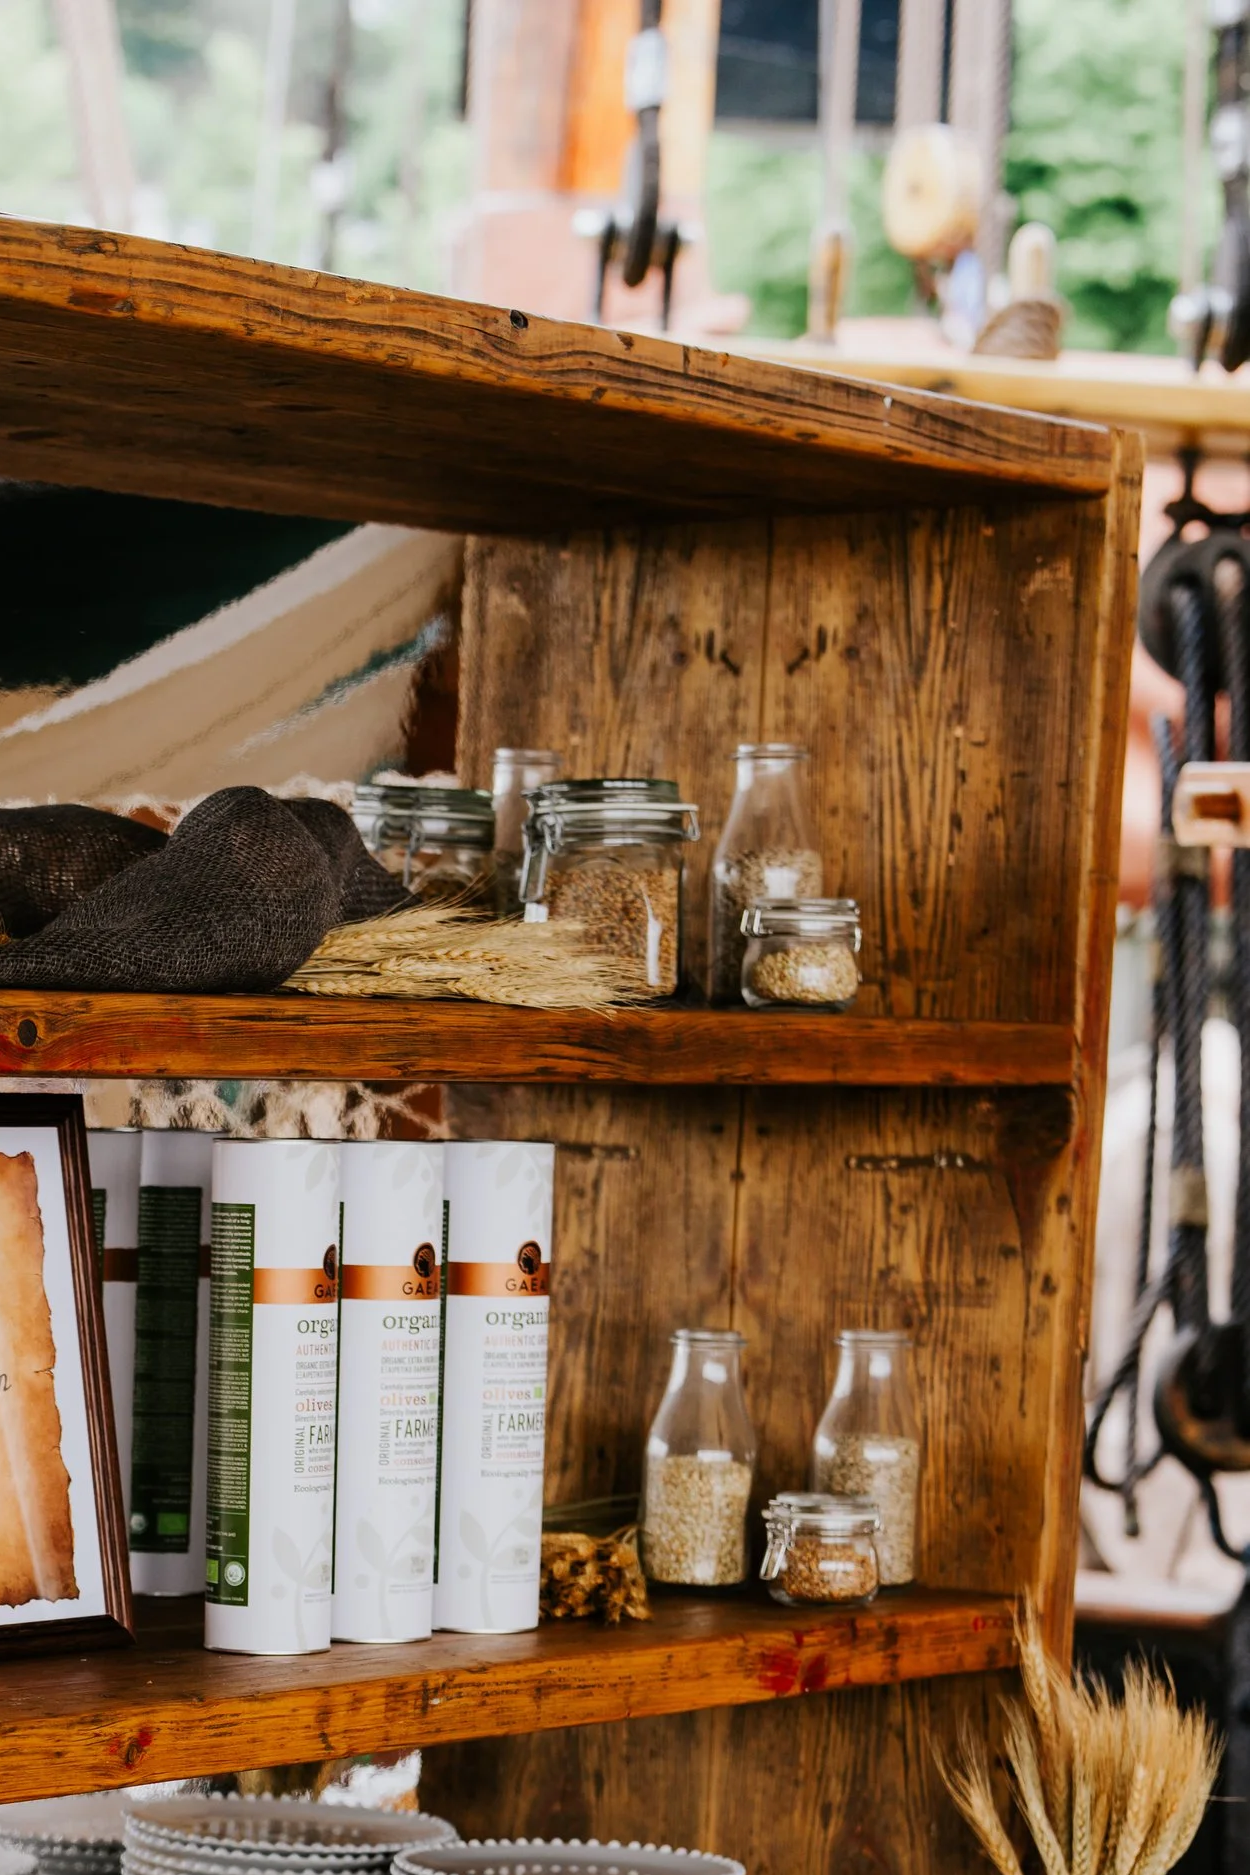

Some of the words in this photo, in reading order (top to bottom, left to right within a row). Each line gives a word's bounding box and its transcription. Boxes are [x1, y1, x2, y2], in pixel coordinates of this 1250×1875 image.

[295, 1398, 333, 1412] olives
[380, 1392, 427, 1406] olives
[483, 1387, 531, 1401] olives
[294, 1426, 305, 1473] ORIGINAL
[379, 1420, 390, 1466] ORIGINAL
[481, 1414, 493, 1459] ORIGINAL
